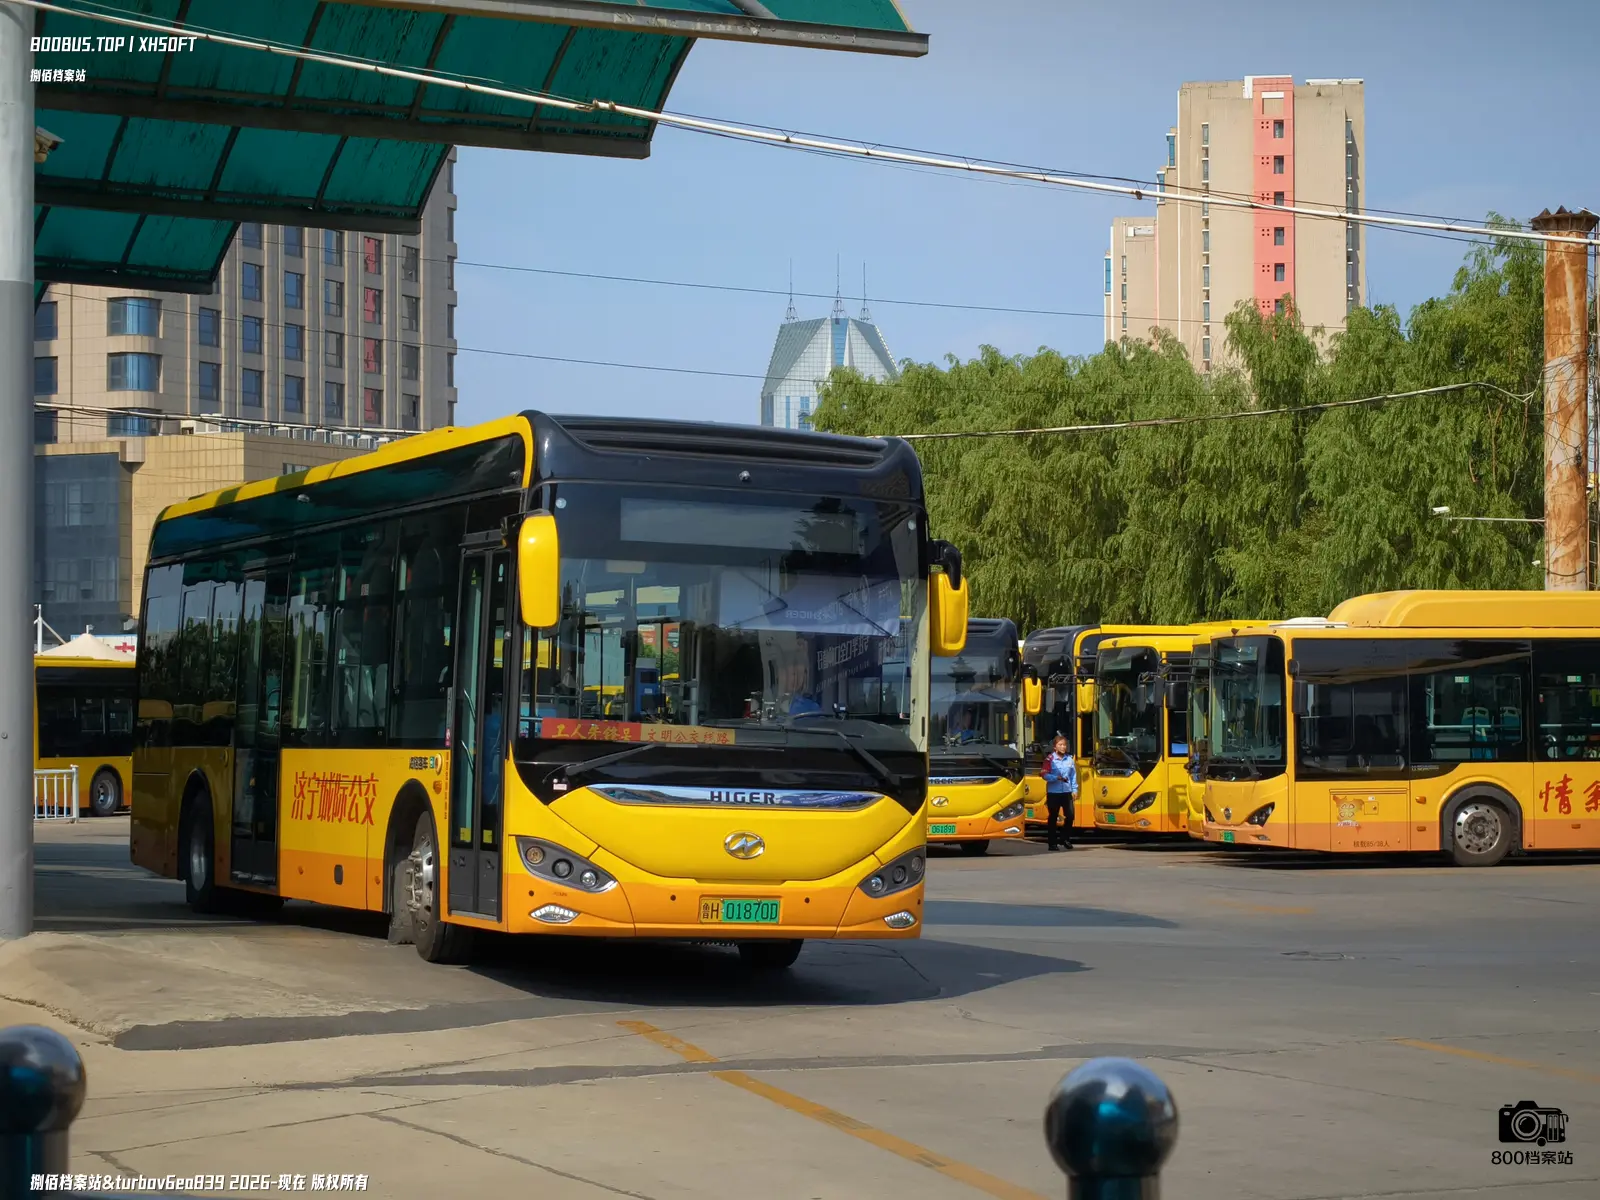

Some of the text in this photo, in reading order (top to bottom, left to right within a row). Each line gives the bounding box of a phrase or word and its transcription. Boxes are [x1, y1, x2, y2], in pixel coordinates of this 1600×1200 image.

[647, 729, 730, 744] 文明公交线路
[291, 771, 379, 826] 济宁城际公交
[710, 790, 776, 805] HIGER
